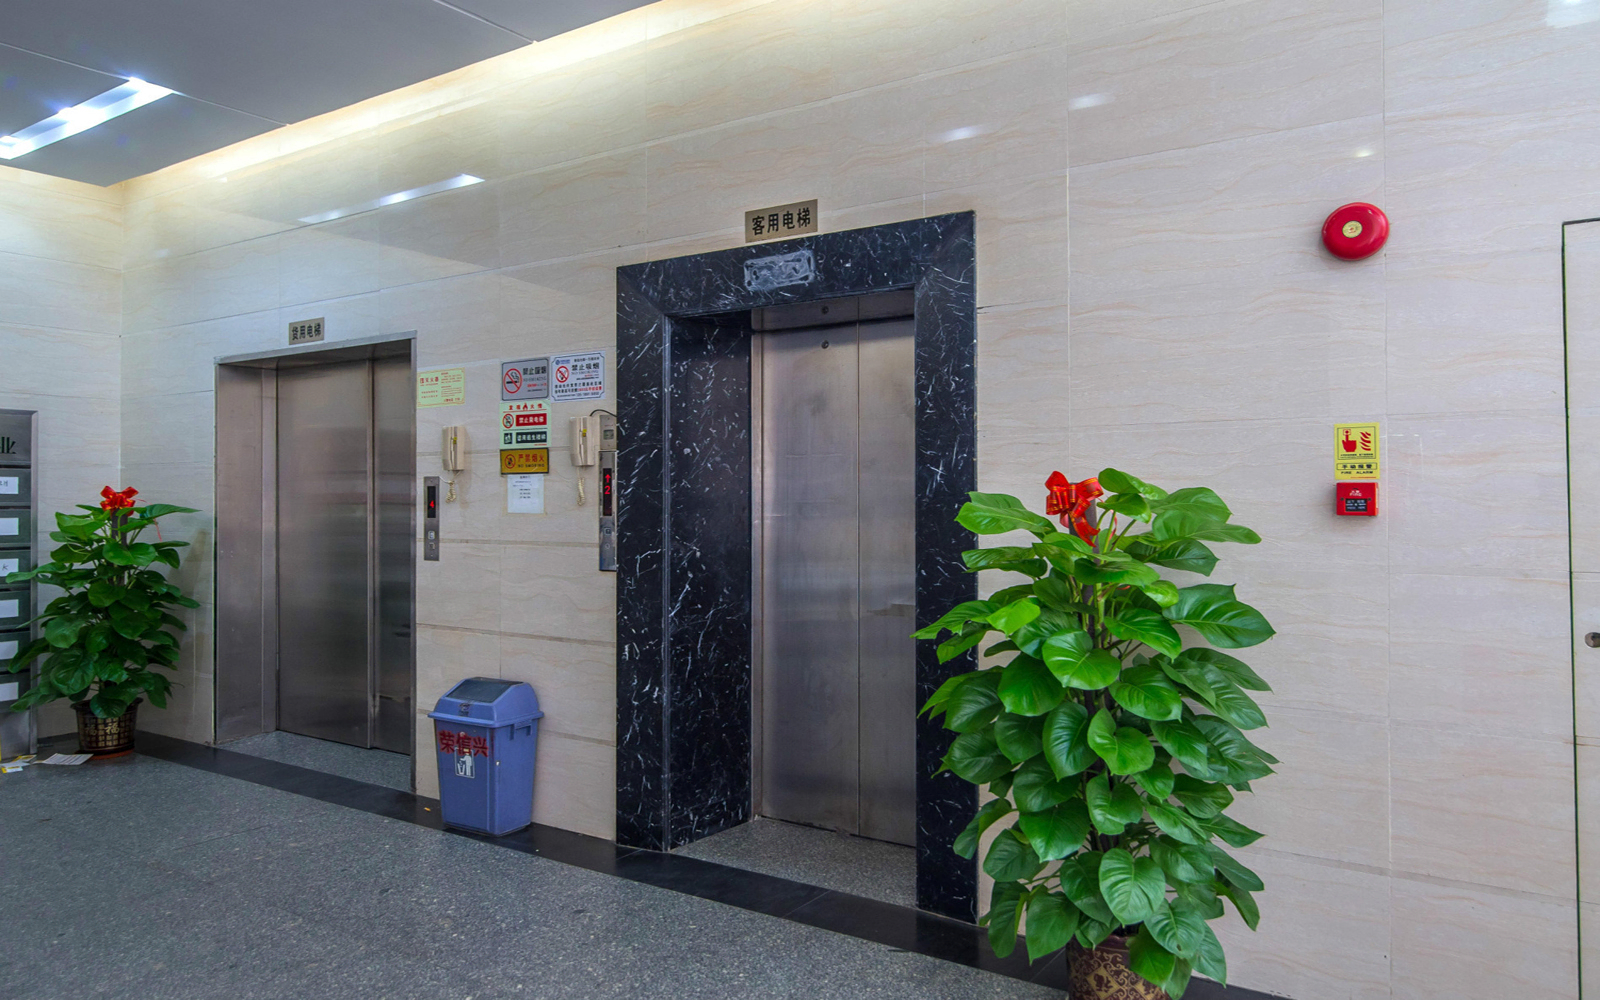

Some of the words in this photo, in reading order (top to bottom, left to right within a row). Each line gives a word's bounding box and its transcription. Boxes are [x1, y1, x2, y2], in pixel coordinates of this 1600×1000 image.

[752, 207, 811, 236] 客用电梯
[571, 362, 600, 371] 禁止吸烟
[517, 453, 545, 463] 严禁烟火
[604, 485, 611, 494] 2
[438, 730, 488, 757] 荣信兴
